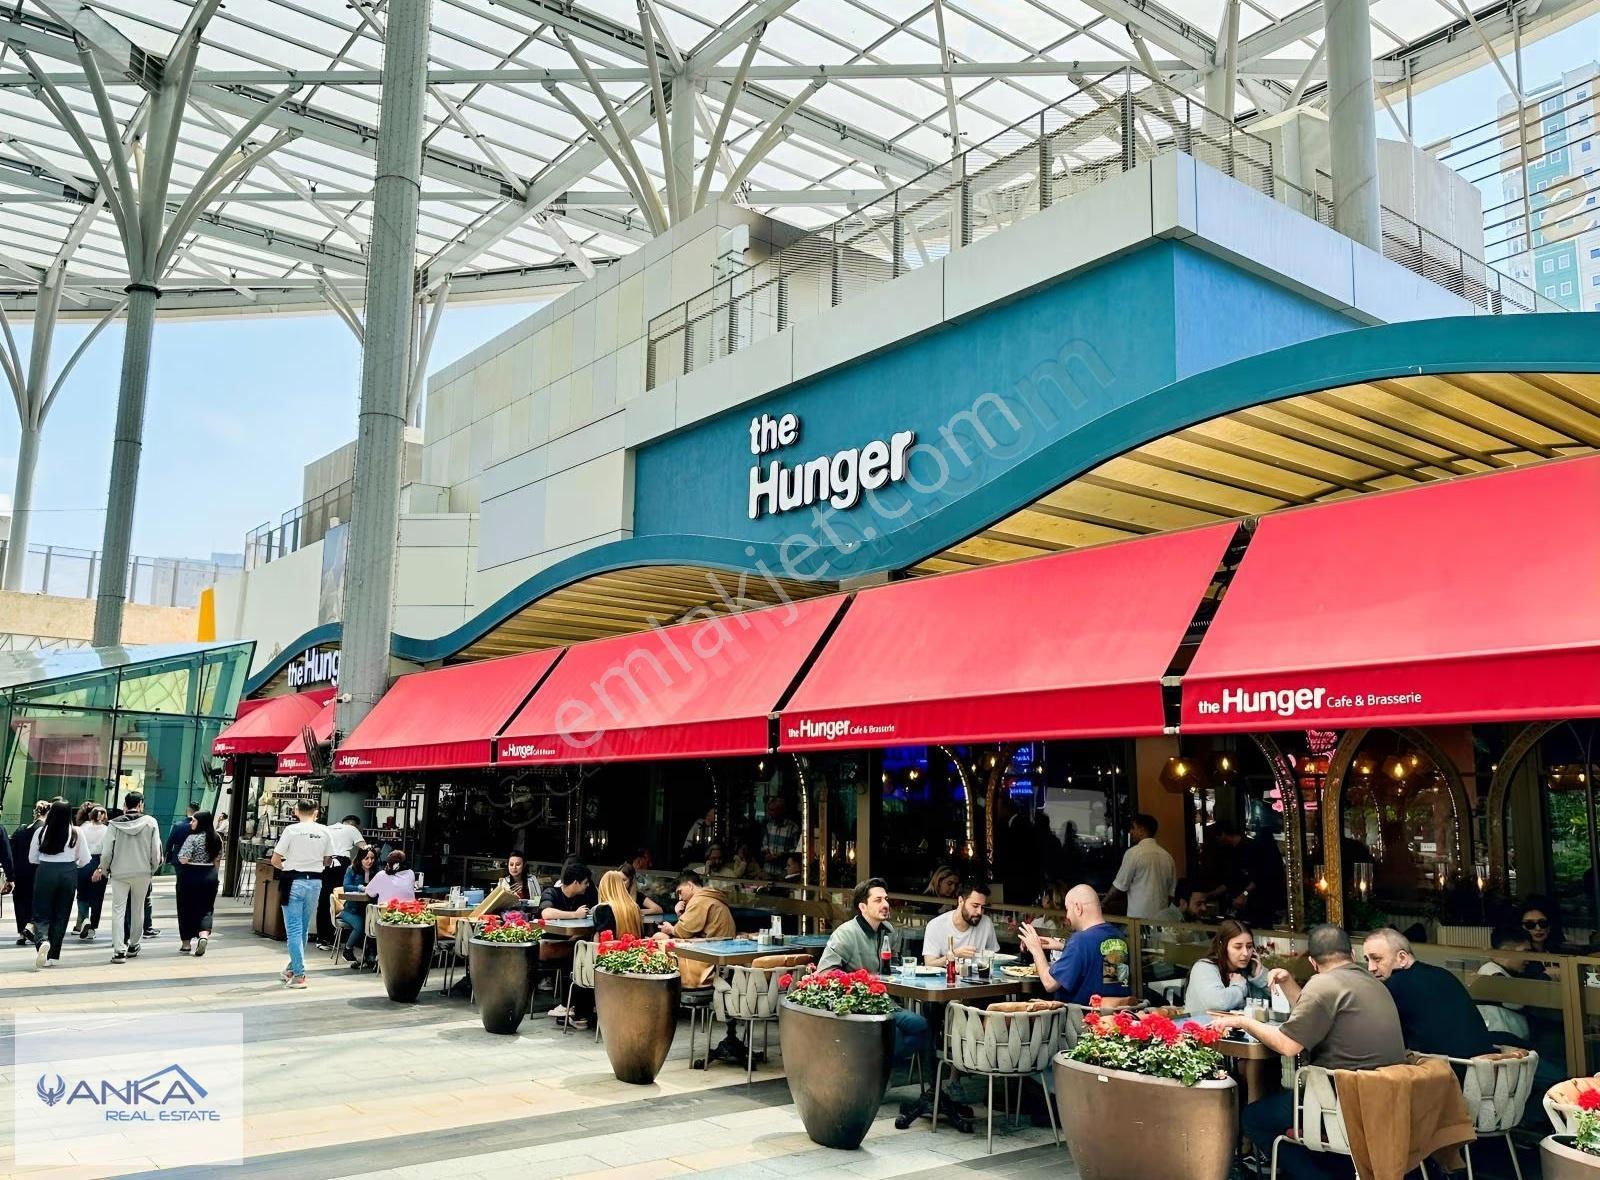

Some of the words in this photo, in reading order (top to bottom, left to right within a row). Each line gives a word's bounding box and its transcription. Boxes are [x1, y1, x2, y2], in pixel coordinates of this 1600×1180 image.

[749, 412, 800, 456] the
[748, 430, 915, 520] Hunger
[287, 662, 303, 687] the
[1198, 700, 1220, 714] the
[1222, 687, 1326, 716] Hunger
[1326, 696, 1353, 708] Cafe
[1355, 697, 1365, 706] &
[1367, 692, 1422, 705] Brasserie
[788, 728, 800, 738] the
[800, 719, 851, 740] Hunger
